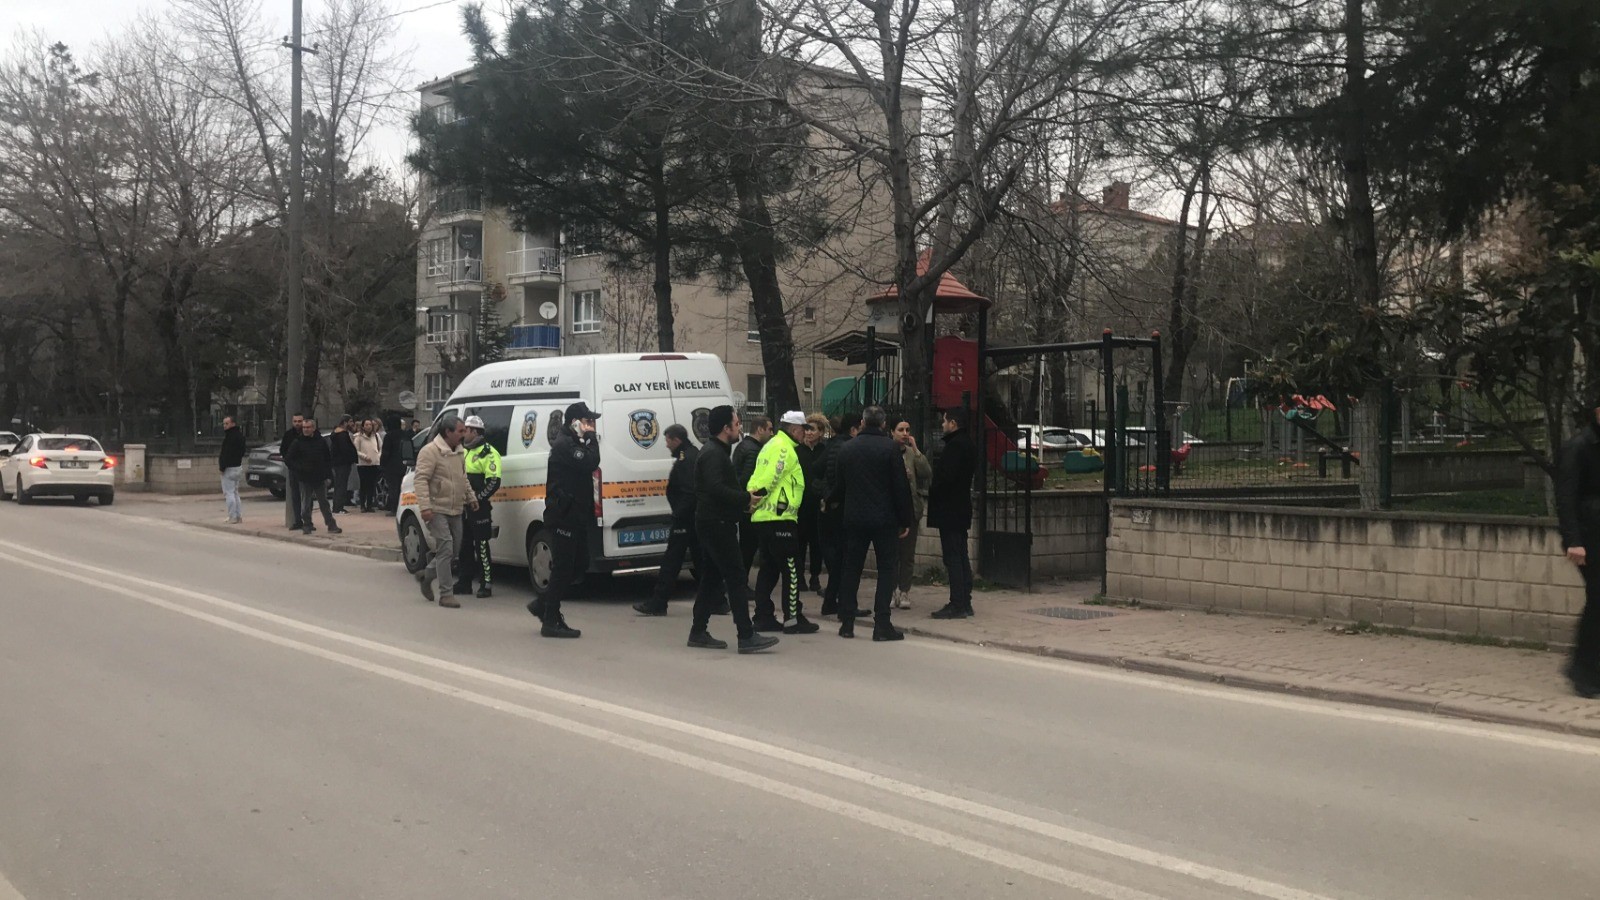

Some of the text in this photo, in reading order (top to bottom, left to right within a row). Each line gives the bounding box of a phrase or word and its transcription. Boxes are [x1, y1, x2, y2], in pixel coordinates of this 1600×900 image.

[491, 379, 504, 388] OLAY
[614, 380, 720, 392] OLAY YERİ İNCELEME
[623, 532, 635, 543] 22
[640, 532, 646, 541] A
